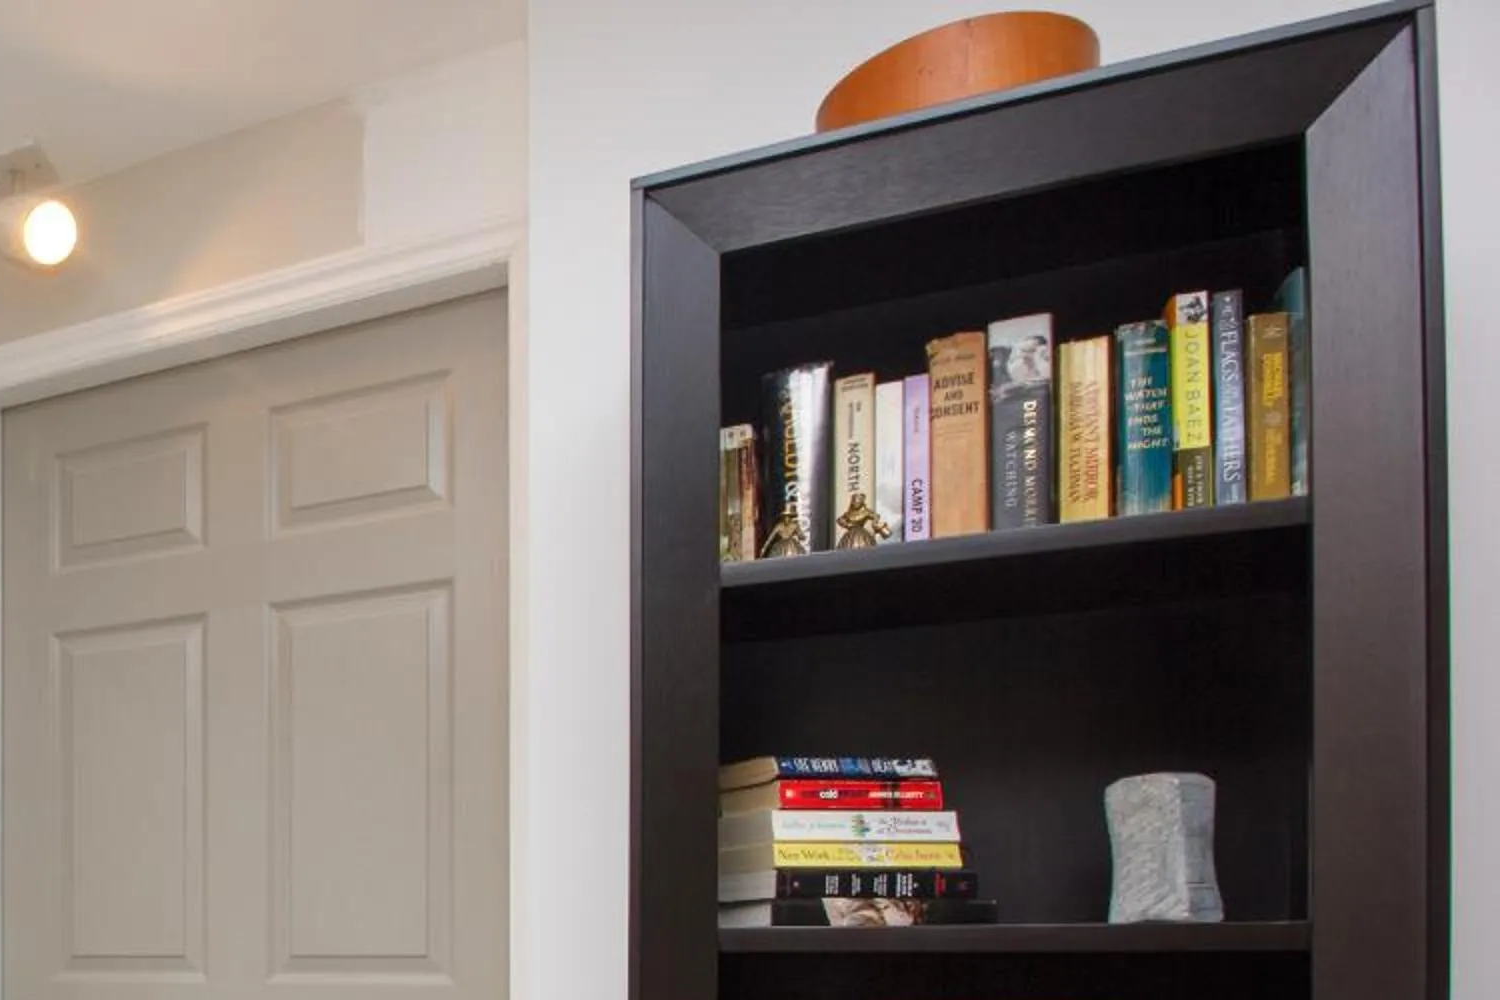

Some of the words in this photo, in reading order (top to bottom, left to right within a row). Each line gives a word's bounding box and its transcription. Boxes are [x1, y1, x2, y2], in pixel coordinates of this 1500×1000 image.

[1186, 330, 1201, 383] JOAN
[1186, 389, 1202, 445] BAEZ
[911, 478, 924, 513] CAMP
